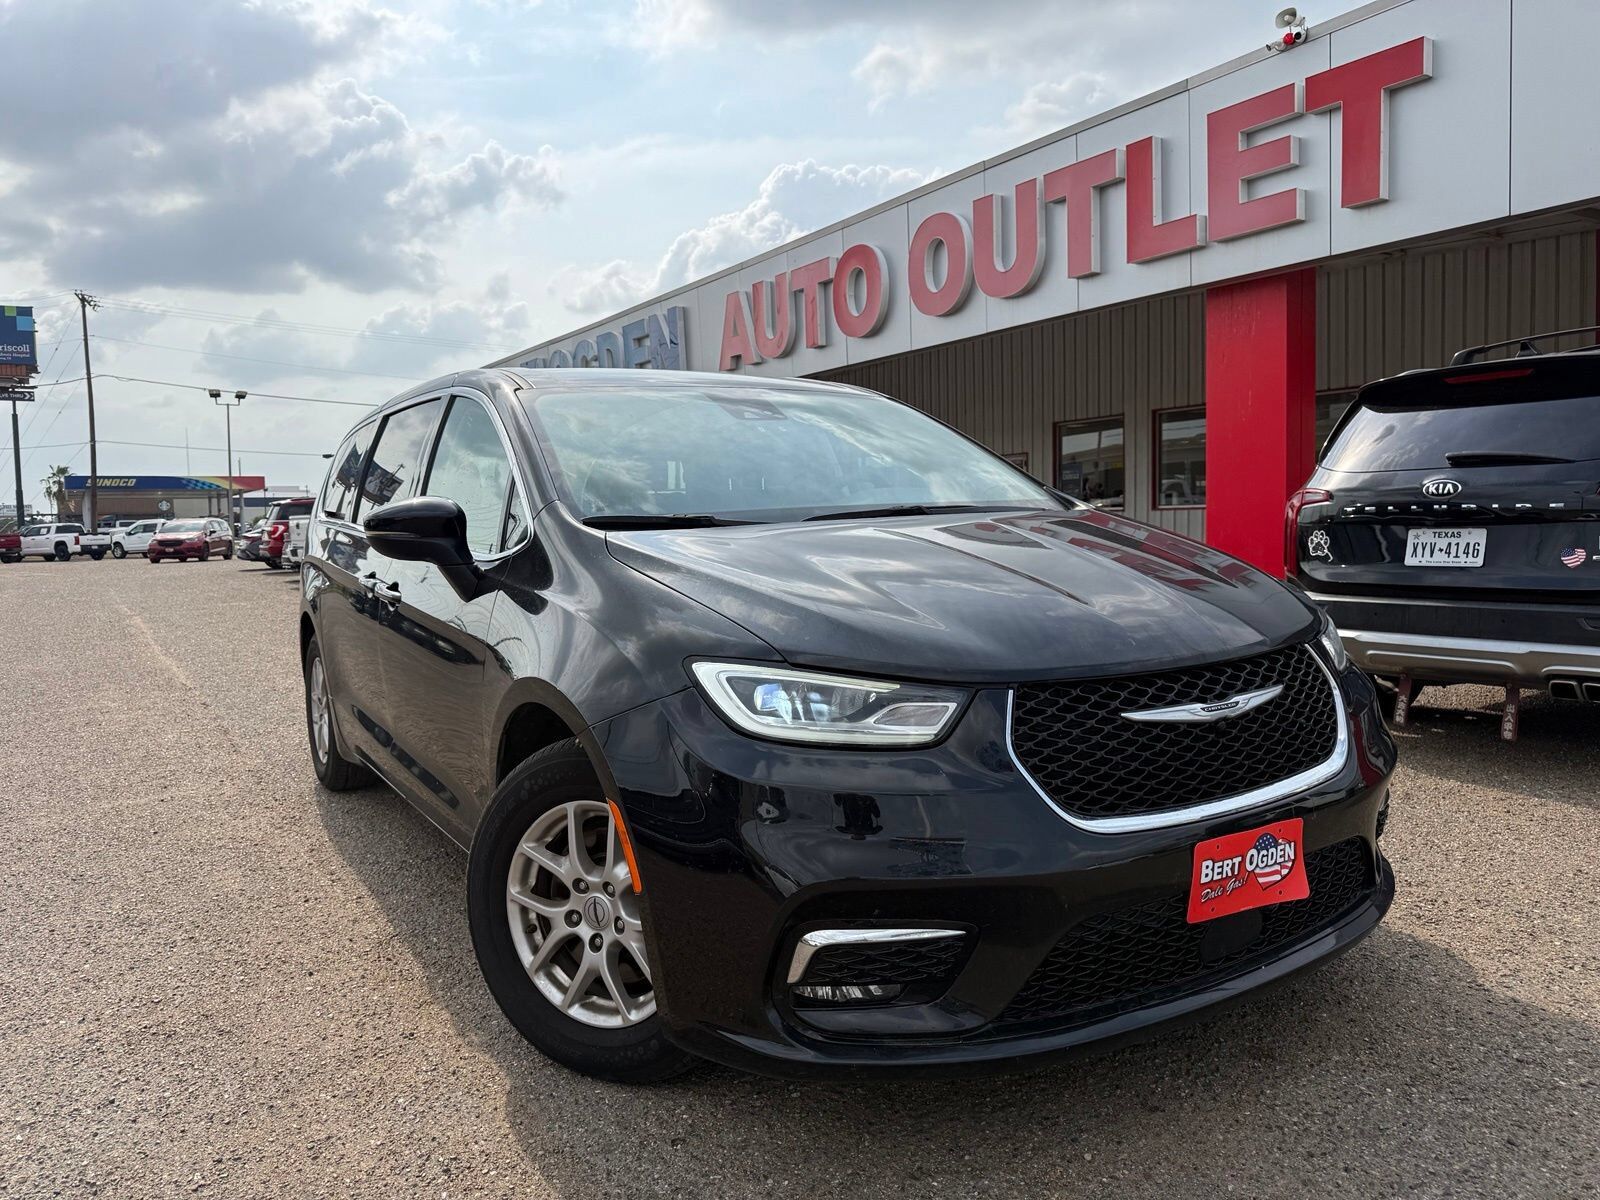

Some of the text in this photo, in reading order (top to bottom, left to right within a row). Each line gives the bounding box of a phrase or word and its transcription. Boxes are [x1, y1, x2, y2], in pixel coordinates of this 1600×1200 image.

[719, 36, 1433, 371] AUTO OUTLET
[0, 344, 30, 352] riscoll
[1427, 482, 1454, 495] KIA
[1432, 531, 1462, 539] TEXAS
[1204, 702, 1237, 712] CHRYSLER
[1200, 841, 1295, 884] BERT OGDEN
[1201, 885, 1223, 903] Dale
